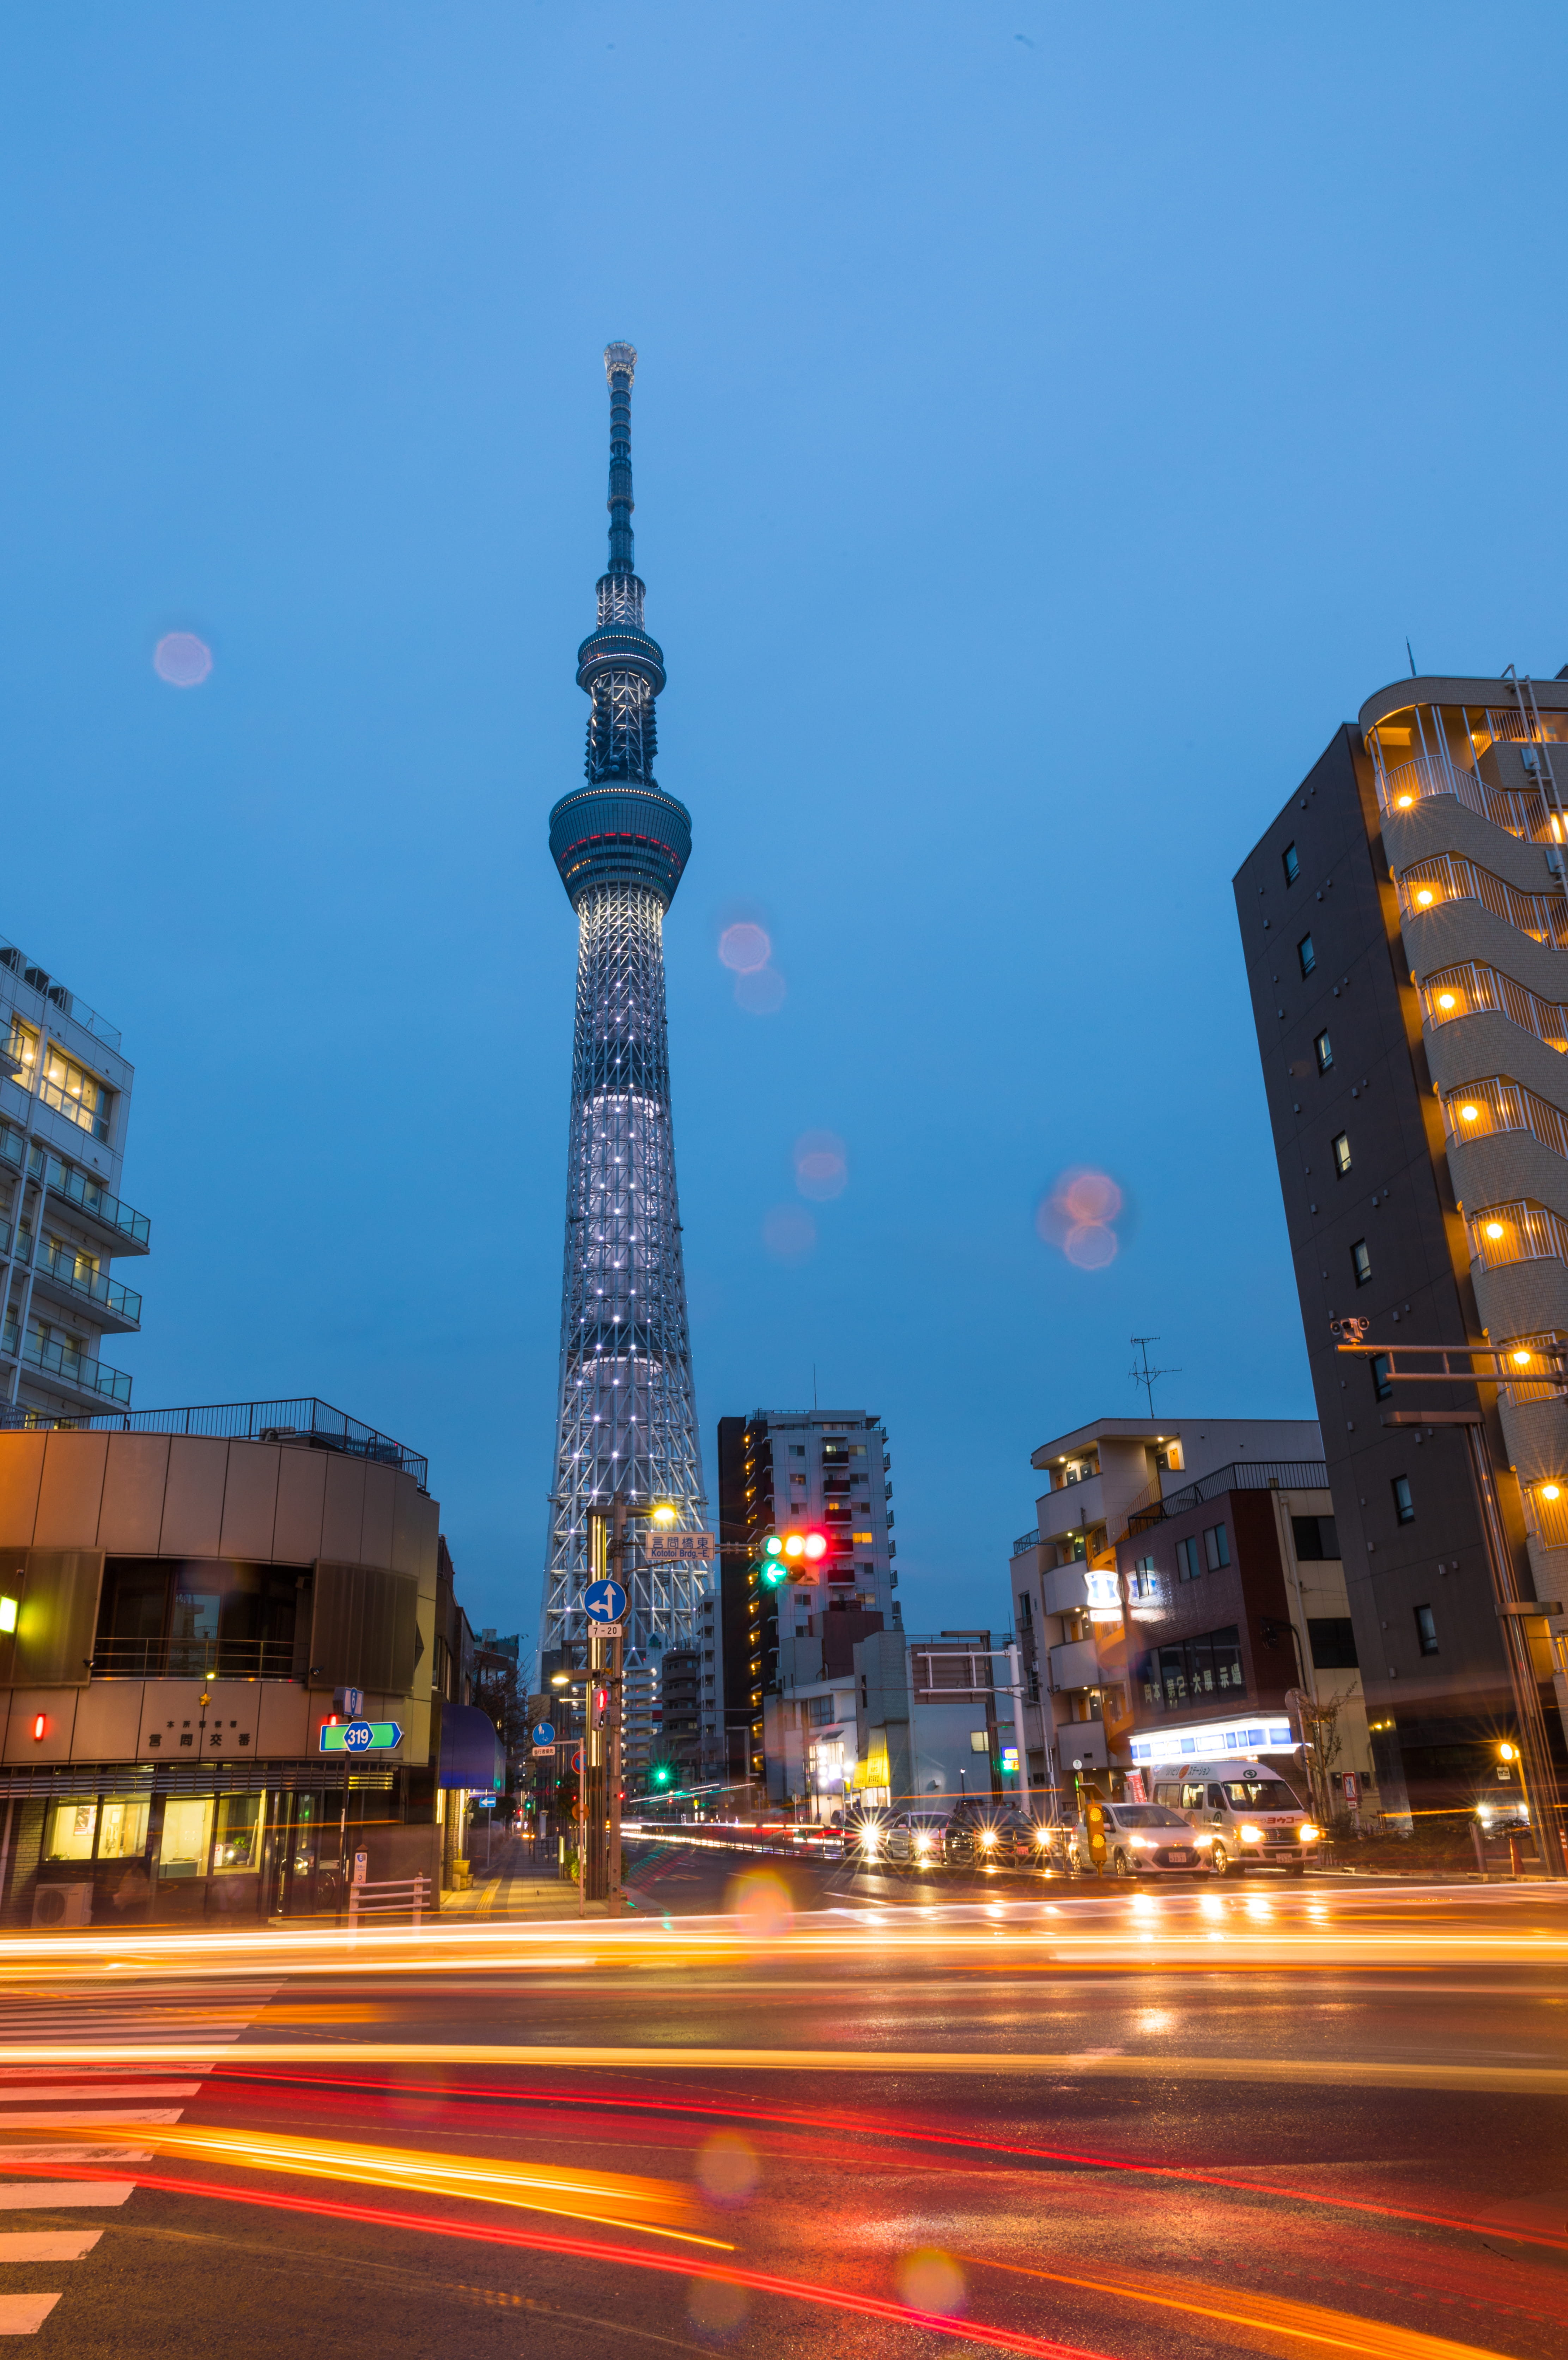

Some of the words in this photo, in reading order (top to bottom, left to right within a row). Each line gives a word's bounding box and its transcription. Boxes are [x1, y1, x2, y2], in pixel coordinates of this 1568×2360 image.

[652, 1536, 709, 1549] 言問橋東
[652, 1549, 677, 1557] Kototoi
[680, 1549, 710, 1559] Brdg.-E.
[352, 1692, 355, 1708] 6
[149, 1733, 250, 1747] 言問交番
[348, 1729, 369, 1745] 319
[1188, 1766, 1211, 1776] ステーション
